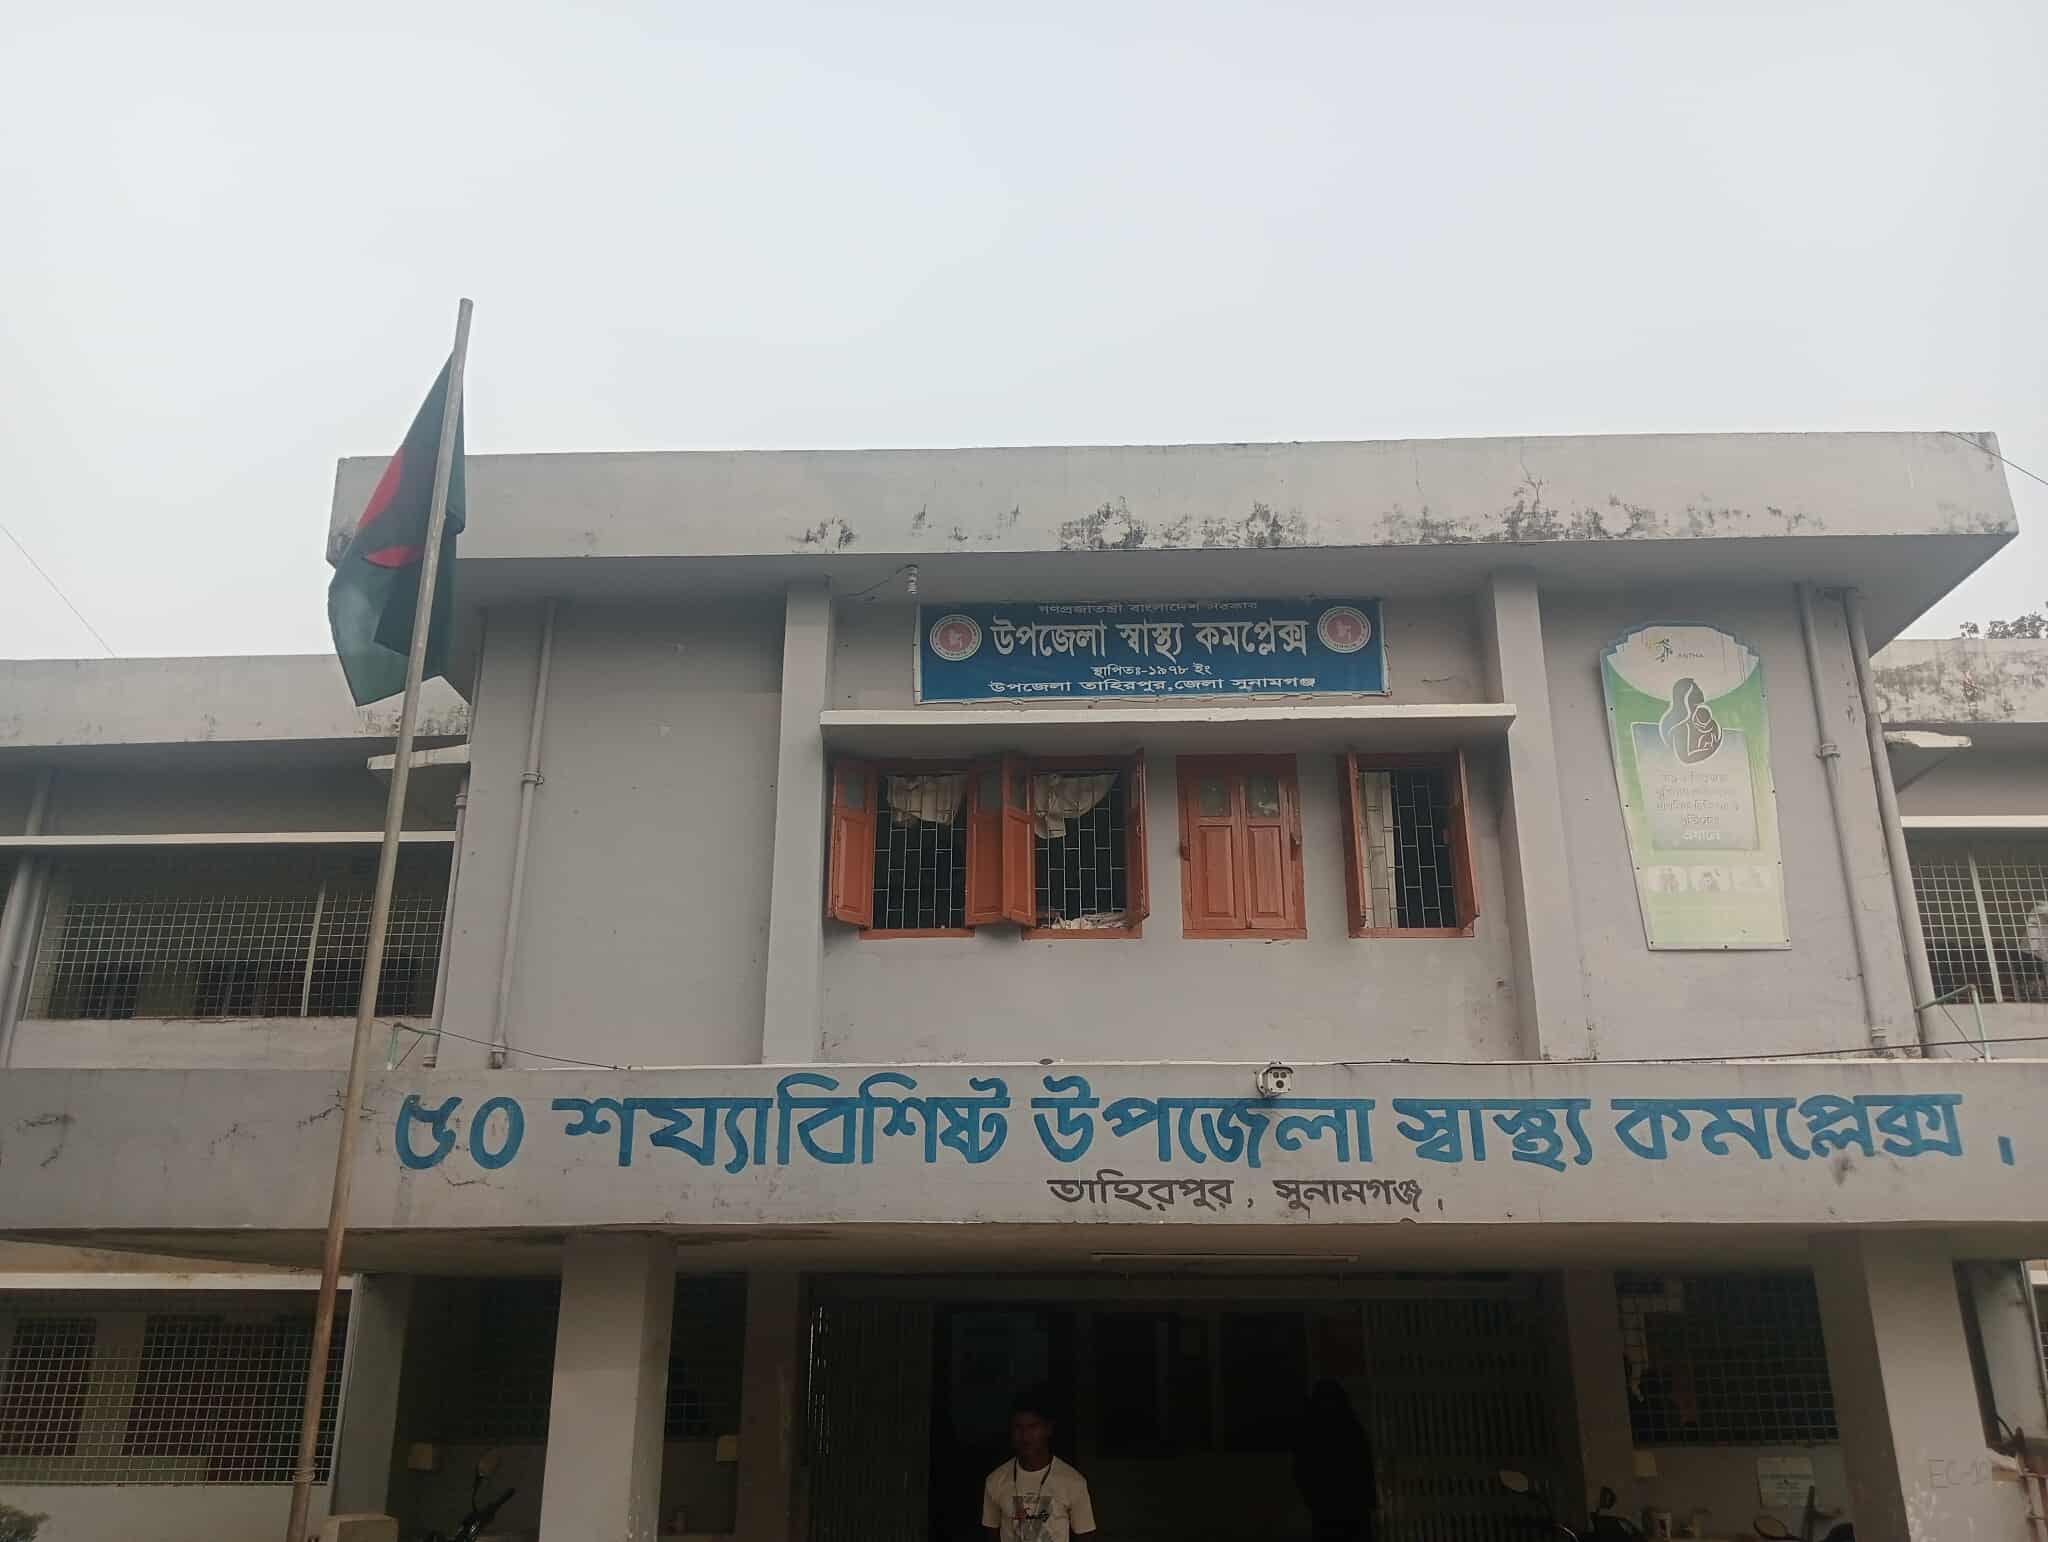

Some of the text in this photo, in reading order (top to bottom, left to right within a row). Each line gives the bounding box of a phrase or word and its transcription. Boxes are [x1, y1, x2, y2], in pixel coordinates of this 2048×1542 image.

[991, 616, 1106, 656] উপজেলা
[1116, 618, 1184, 663] স্বাস্থ্য
[1192, 617, 1308, 656] কমপ্লেক্স
[988, 680, 1071, 693] উপজেলা
[1231, 676, 1316, 690] সুনামগঞ্জ
[1194, 663, 1213, 677] ইং
[396, 1096, 523, 1169] ৫০
[552, 1073, 1009, 1172] শয্যাবিশিষ্ট
[1032, 1075, 1374, 1167] উপজেলা
[1392, 1099, 1590, 1169] স্বাস্থ্য
[1613, 1095, 1961, 1159] কমপ্লেক্স
